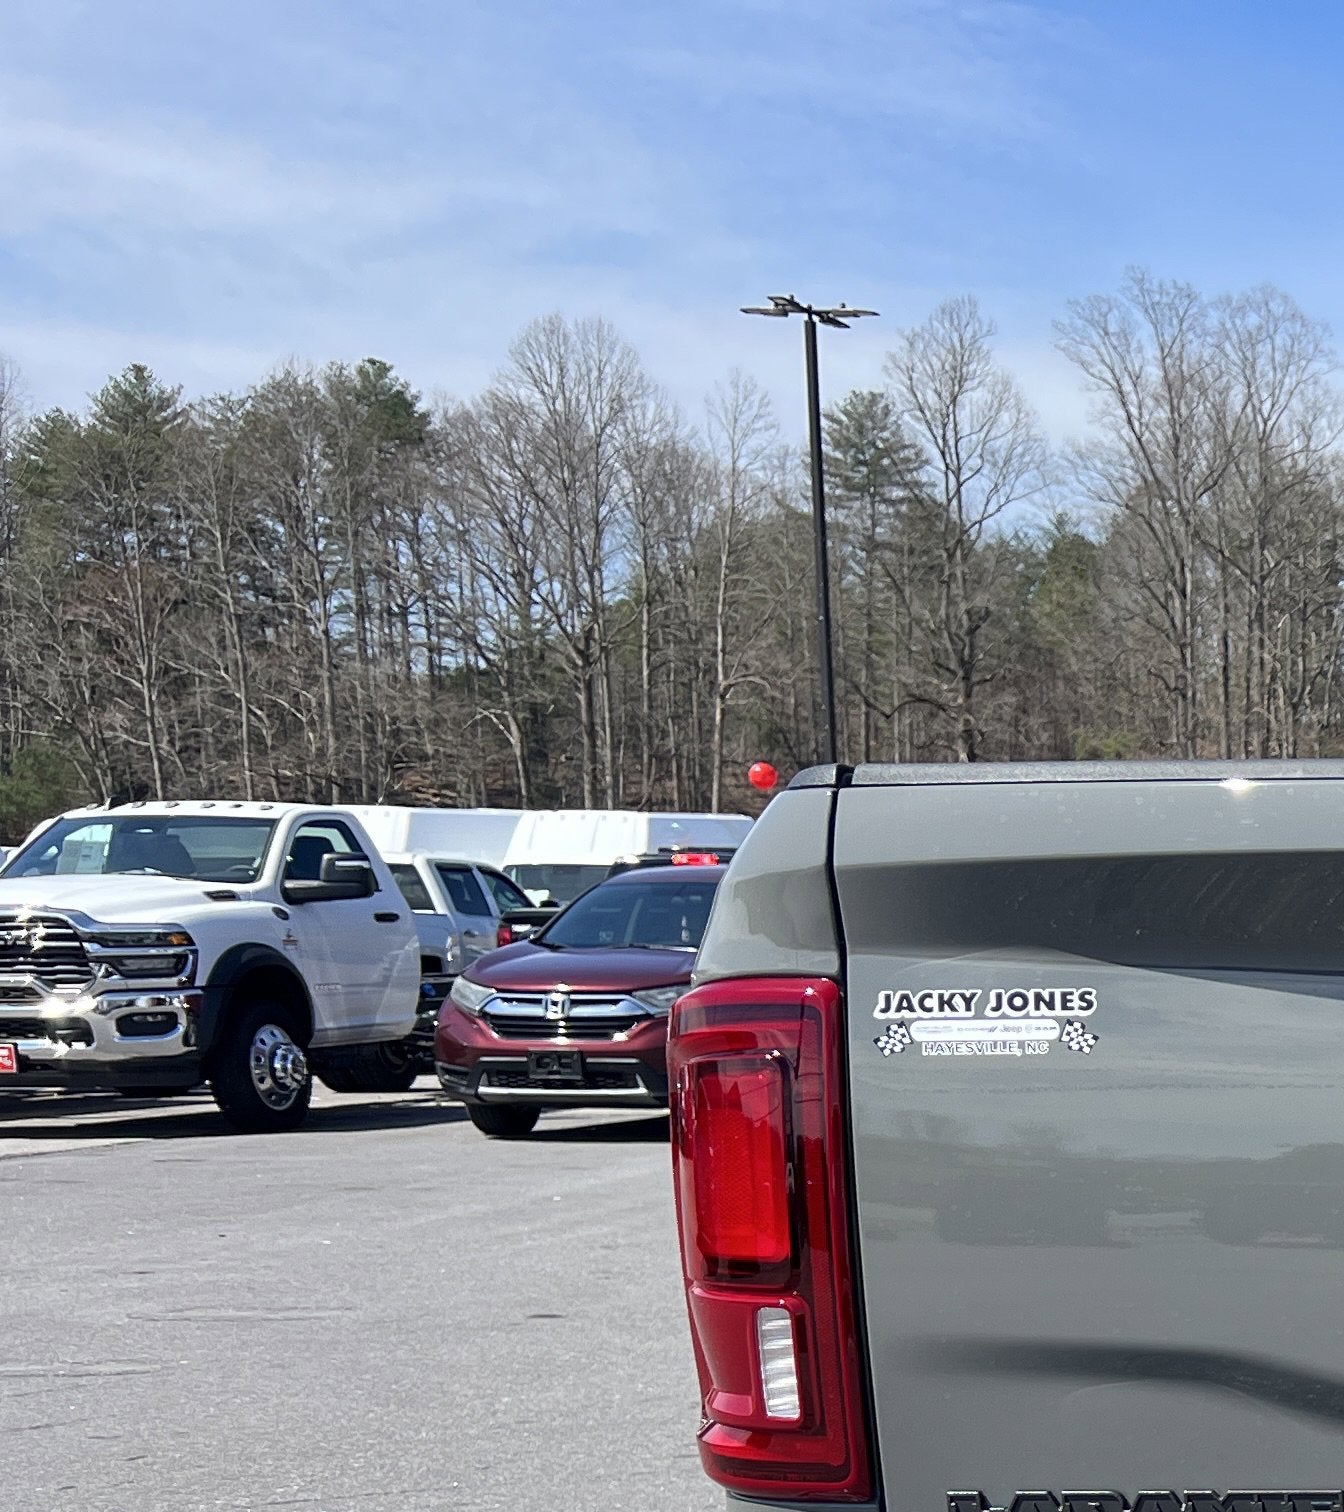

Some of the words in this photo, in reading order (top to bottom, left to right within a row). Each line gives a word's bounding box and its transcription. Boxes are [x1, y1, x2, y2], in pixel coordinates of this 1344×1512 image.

[876, 991, 979, 1016] JACKY
[987, 990, 1096, 1014] JONES
[923, 1042, 1022, 1056] HAYESVILLE,
[1026, 1041, 1050, 1054] NC
